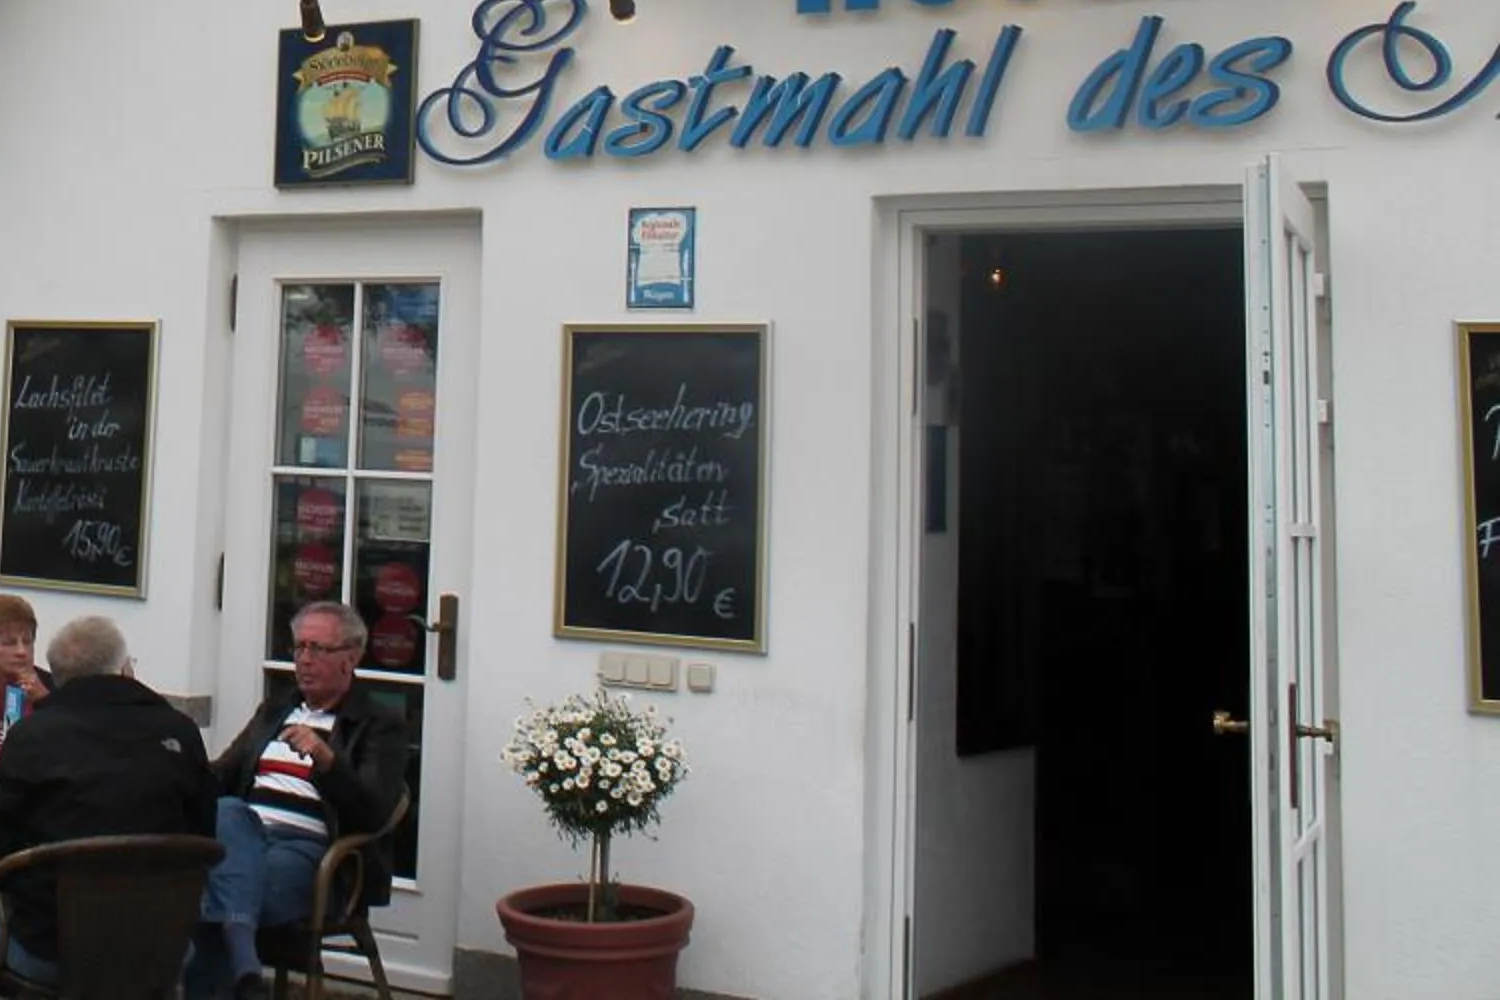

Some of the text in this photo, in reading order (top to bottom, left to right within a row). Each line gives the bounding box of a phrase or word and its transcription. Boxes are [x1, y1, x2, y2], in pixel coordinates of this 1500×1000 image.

[1065, 15, 1293, 132] des
[302, 132, 386, 170] PILSENER
[596, 539, 713, 613] 12,90
